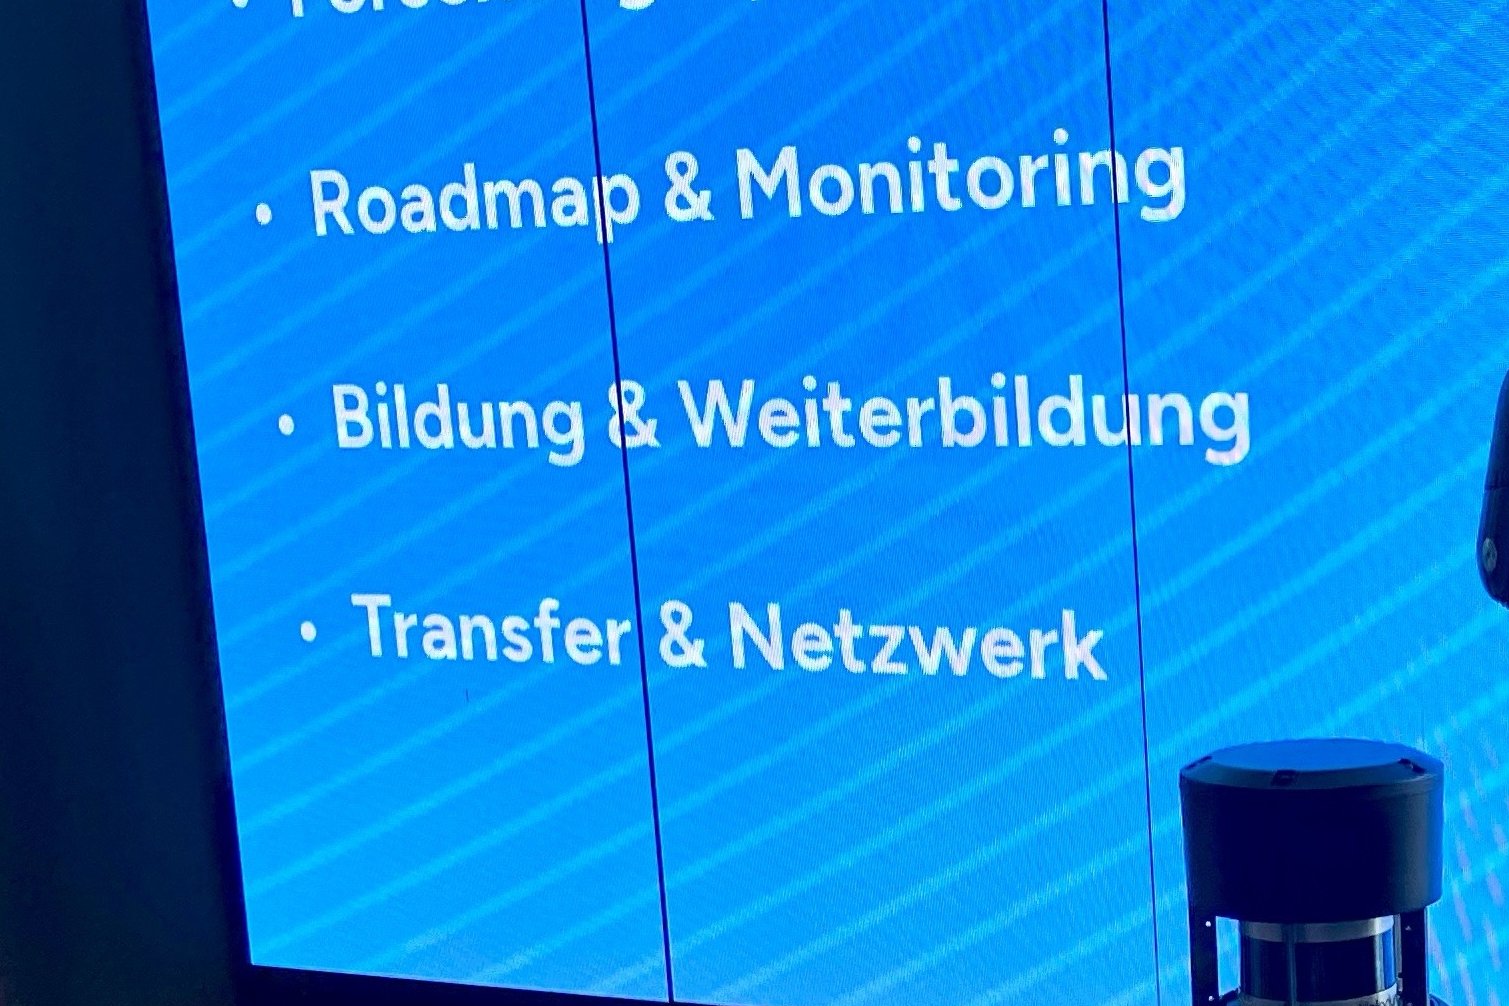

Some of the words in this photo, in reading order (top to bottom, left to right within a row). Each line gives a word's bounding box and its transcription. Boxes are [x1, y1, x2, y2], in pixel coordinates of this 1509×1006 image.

[310, 163, 640, 244] Roadmap
[664, 151, 713, 221] &
[736, 128, 1186, 222] Monitoring
[332, 381, 585, 466] Bildung
[608, 379, 660, 449] &
[677, 372, 1250, 466] Weiterbildung
[351, 594, 631, 665] Transfer
[659, 600, 706, 668] &
[729, 602, 1107, 681] Netzwerk
